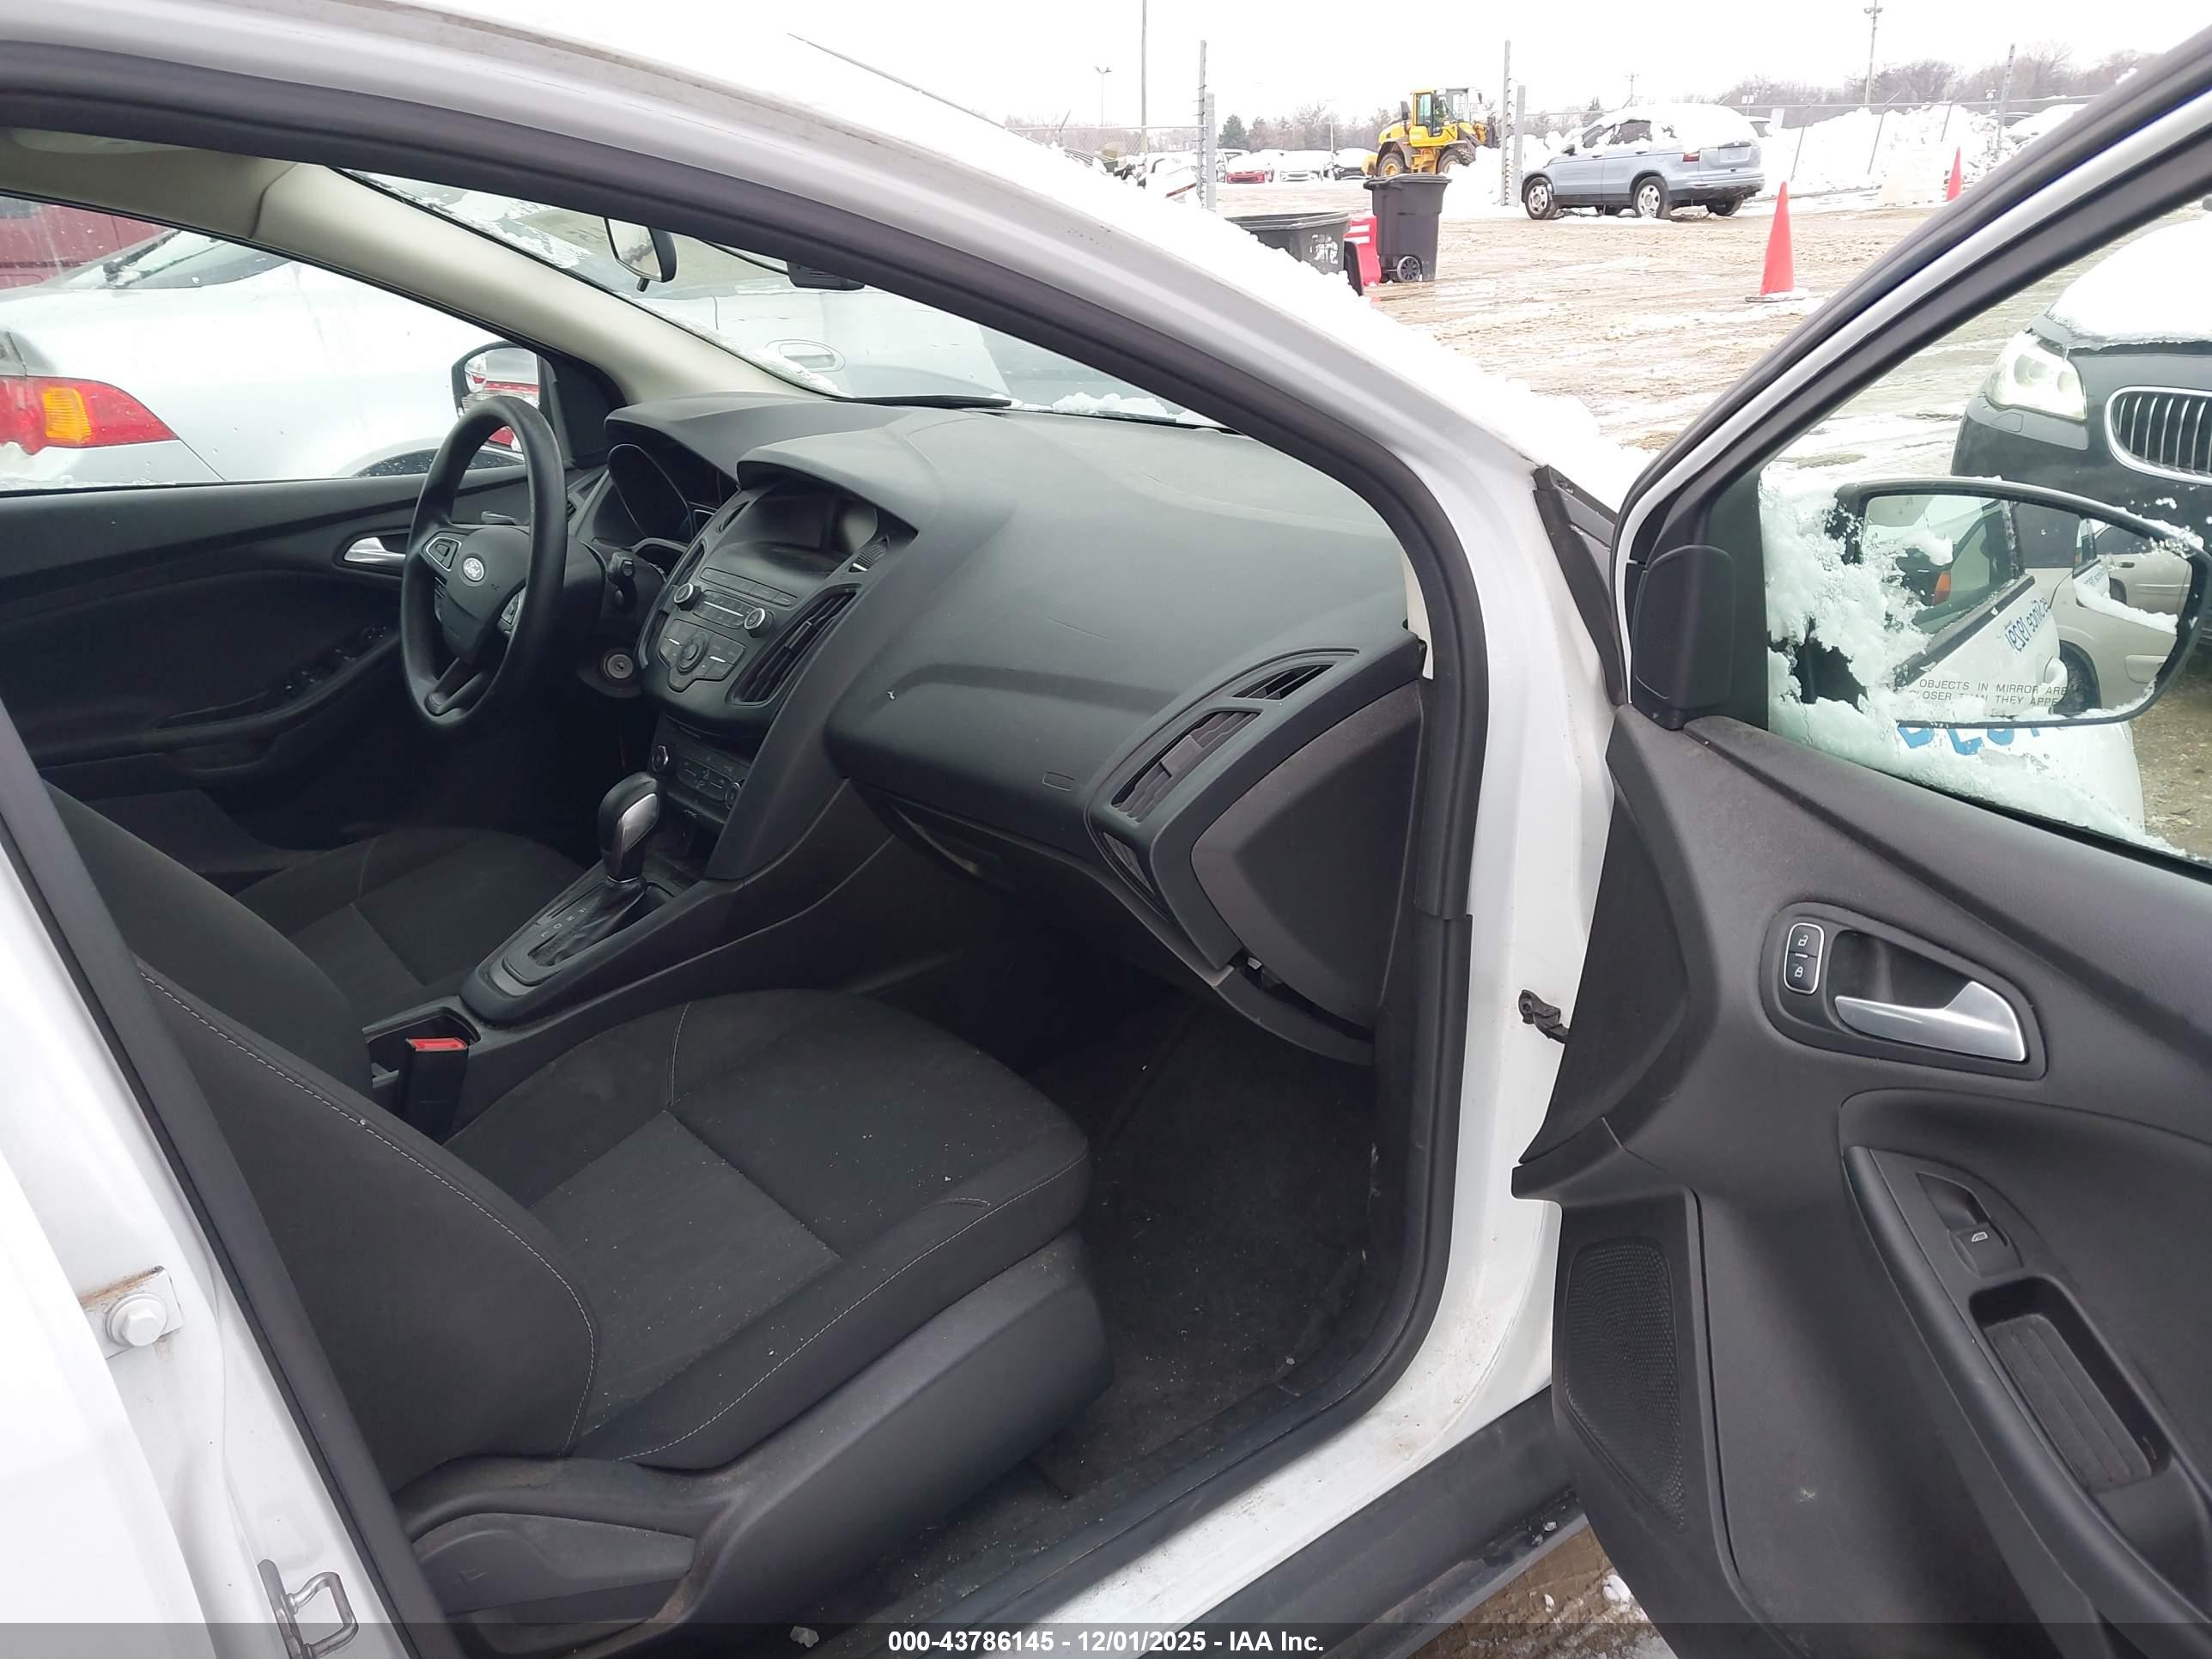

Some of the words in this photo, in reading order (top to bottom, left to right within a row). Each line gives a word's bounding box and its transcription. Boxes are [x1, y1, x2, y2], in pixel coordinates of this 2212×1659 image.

[465, 560, 481, 578] Ford
[1919, 678, 1970, 690] OBJECTS
[1978, 682, 1988, 691] IN
[1996, 683, 2039, 694] MIRROR
[2045, 686, 2068, 696] ARE
[1995, 695, 2024, 704] THEY
